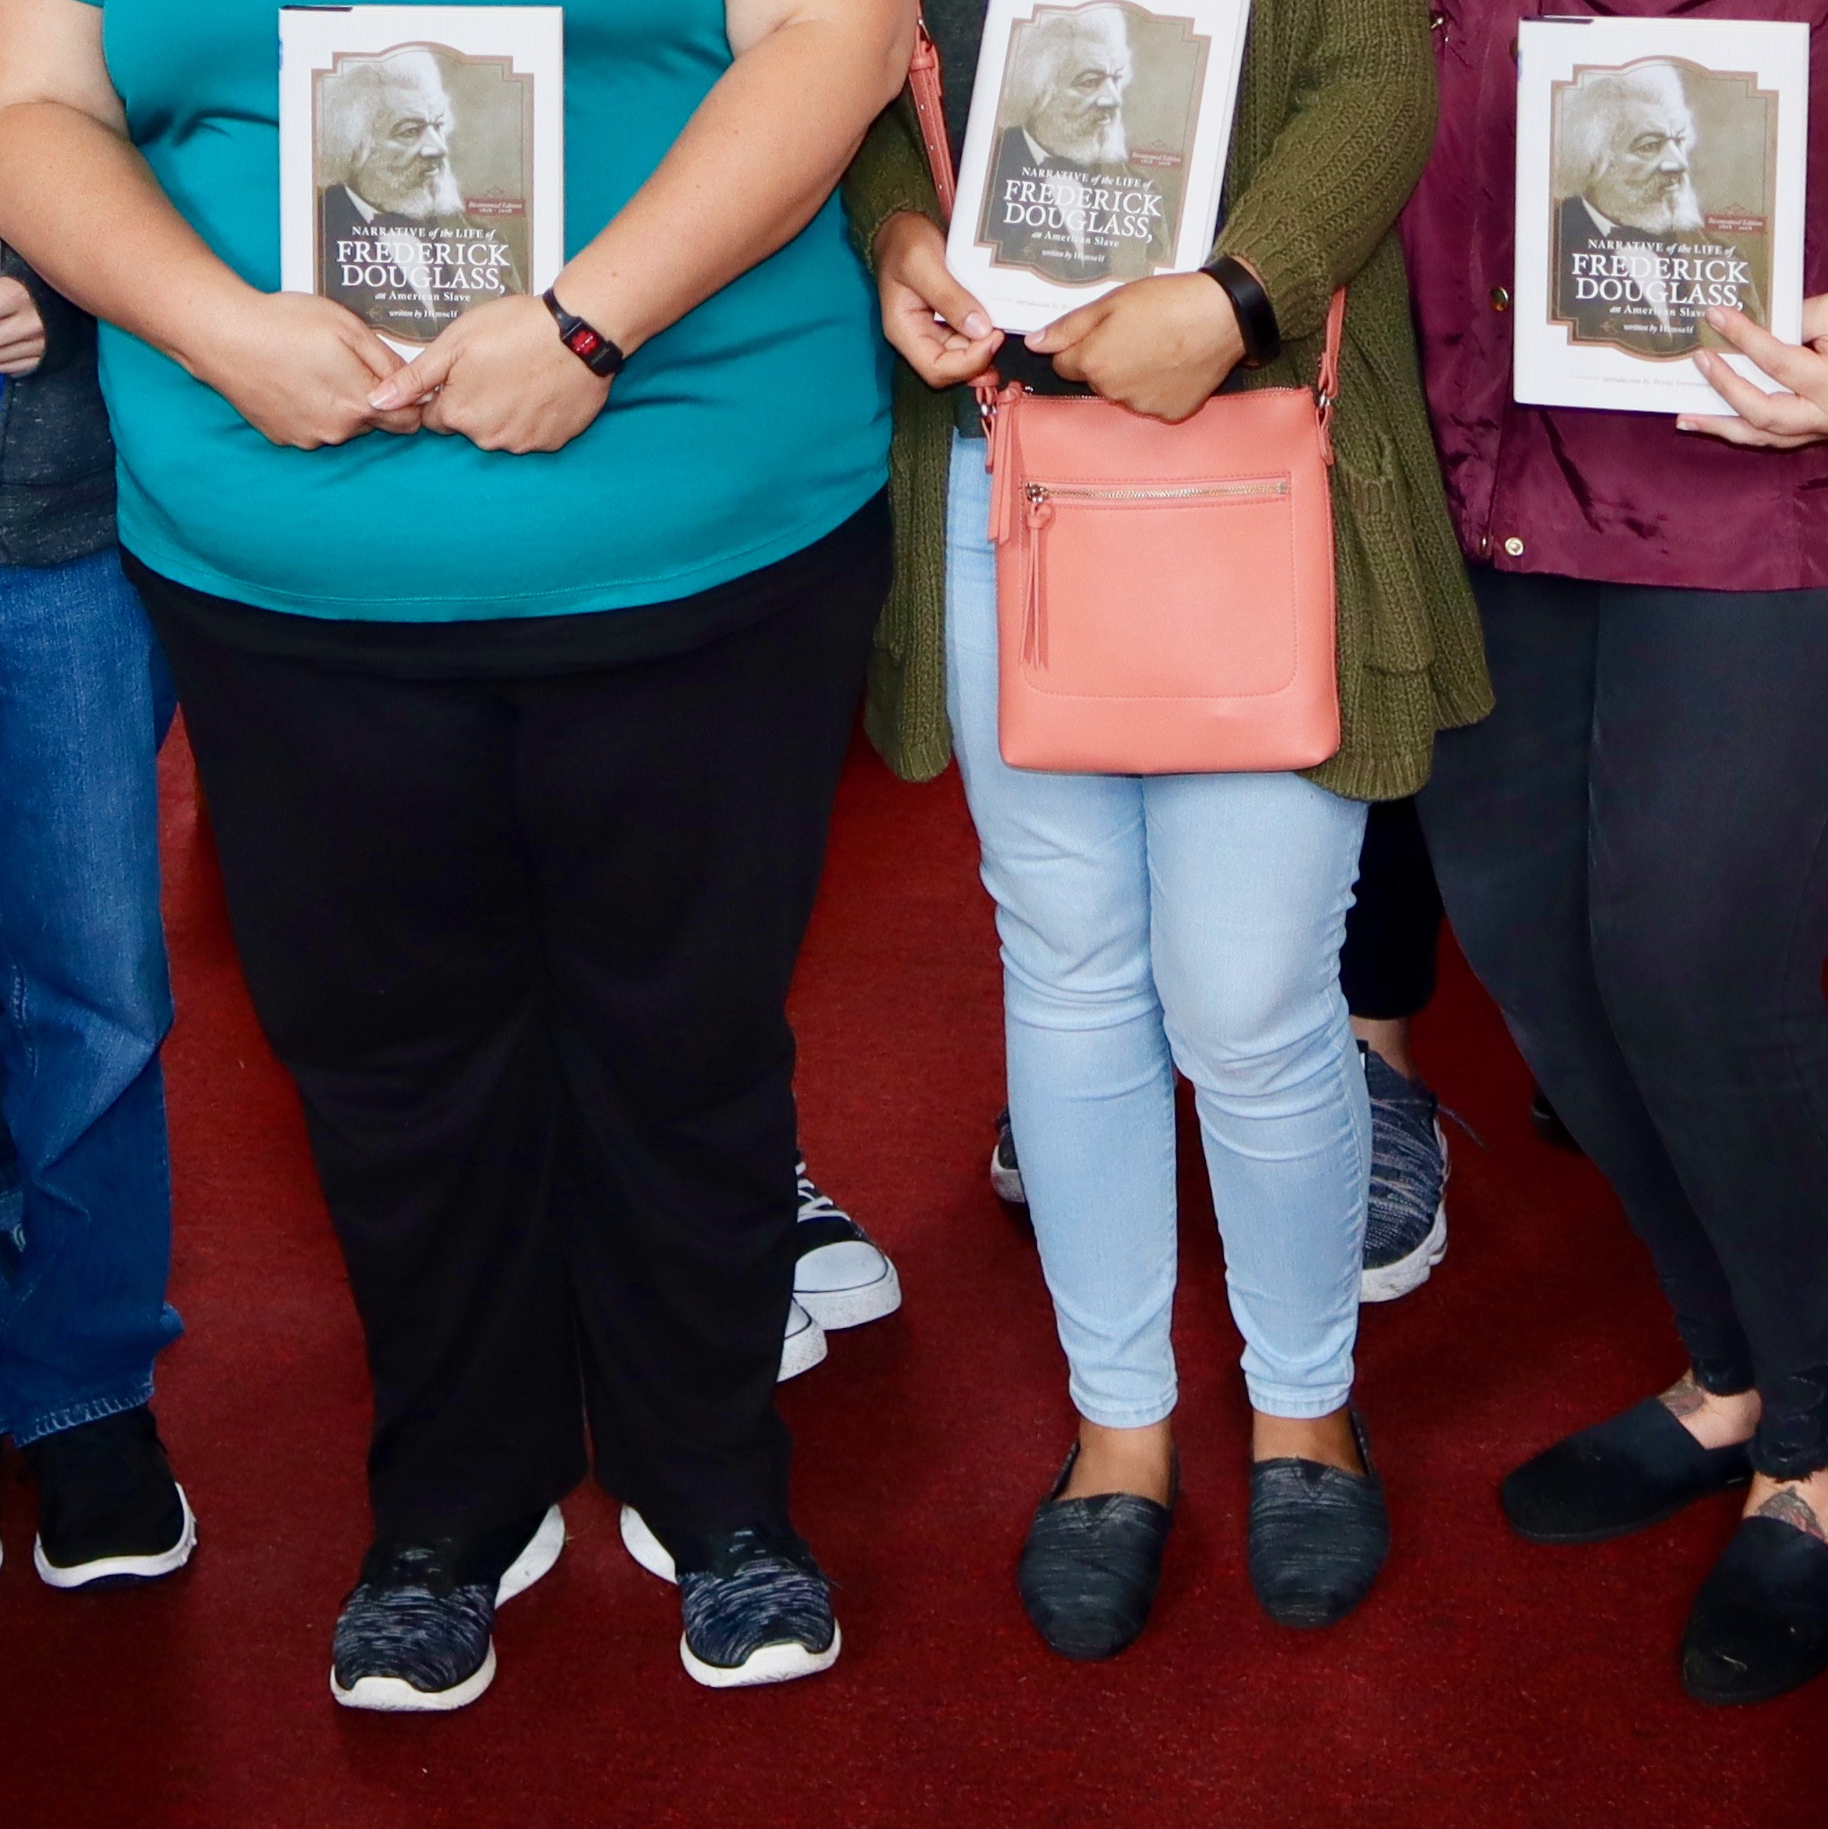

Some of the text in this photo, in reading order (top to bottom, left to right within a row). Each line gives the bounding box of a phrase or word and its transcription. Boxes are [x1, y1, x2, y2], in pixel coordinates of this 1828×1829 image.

[1021, 166, 1154, 191] NARRATIVE of the LIFE of
[1004, 179, 1163, 217] FREDERICK
[352, 226, 497, 241] NARRATIVE of the LIFE of
[1003, 202, 1153, 243] DOUGLASS,
[1044, 231, 1091, 245] American
[1094, 235, 1120, 248] Slave
[1587, 238, 1736, 258] NARRATIVE of the LIFE of
[337, 240, 511, 267] FREDERICK
[341, 265, 506, 294] DOUGLASS,
[1571, 252, 1749, 284] FREDERICK
[388, 291, 440, 301] American
[443, 292, 471, 302] Slave
[1575, 277, 1744, 311] DOUGLASS,
[1623, 305, 1676, 316] American
